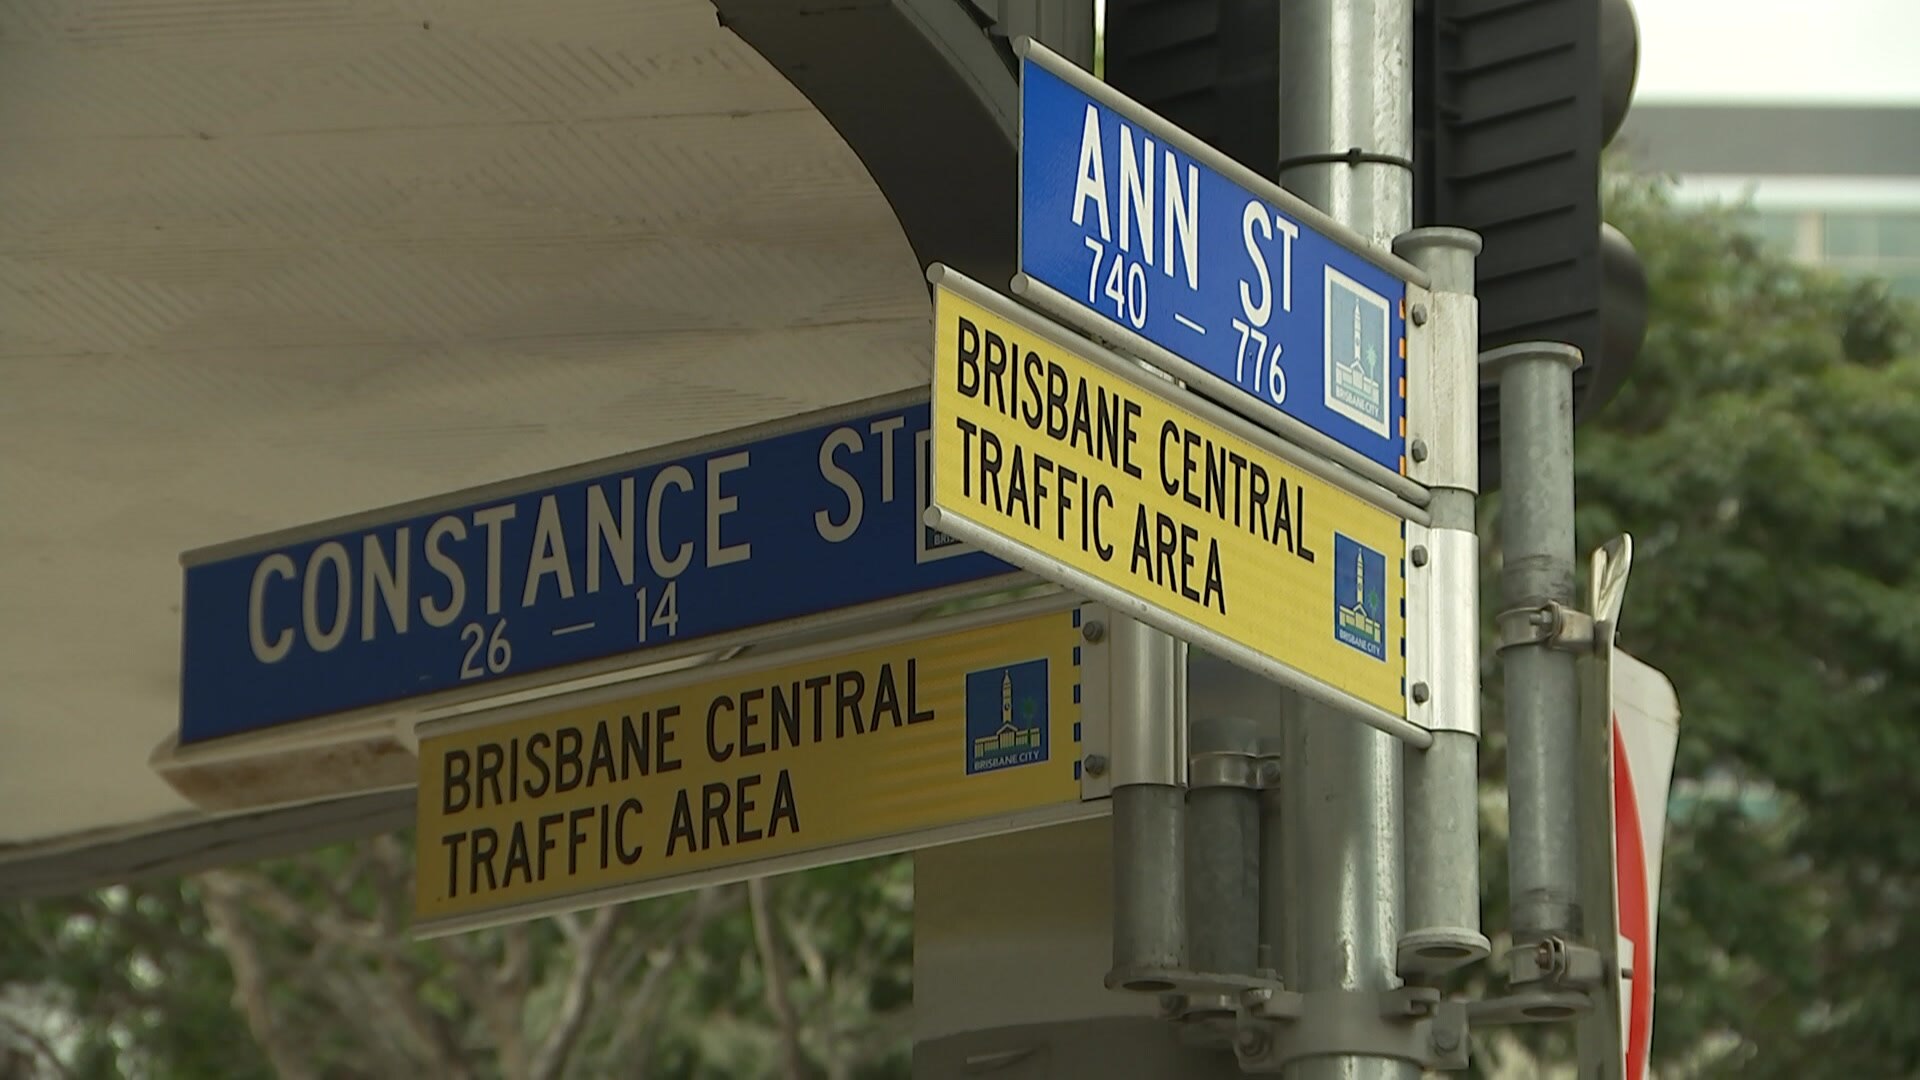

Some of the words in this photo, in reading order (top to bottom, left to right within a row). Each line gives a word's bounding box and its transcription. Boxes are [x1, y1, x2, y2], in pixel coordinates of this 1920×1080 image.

[1071, 103, 1199, 291] ANN
[1239, 201, 1299, 328] ST
[1085, 236, 1148, 330] 740
[1231, 317, 1286, 405] 776
[956, 417, 1114, 562] TRAFFIC
[1130, 503, 1226, 615] AREA
[957, 316, 1142, 480] BRISBANE
[1159, 420, 1315, 564] CENTRAL
[247, 450, 752, 664] CONSTANCE
[814, 416, 905, 544] ST
[459, 618, 512, 680] 26
[636, 581, 679, 643] 14
[441, 705, 683, 816] BRISBANE
[706, 658, 935, 763] CENTRAL
[974, 754, 1018, 771] BRISBANE
[1018, 749, 1040, 761] CITY
[441, 798, 643, 899] TRAFFIC
[665, 768, 800, 857] AREA
